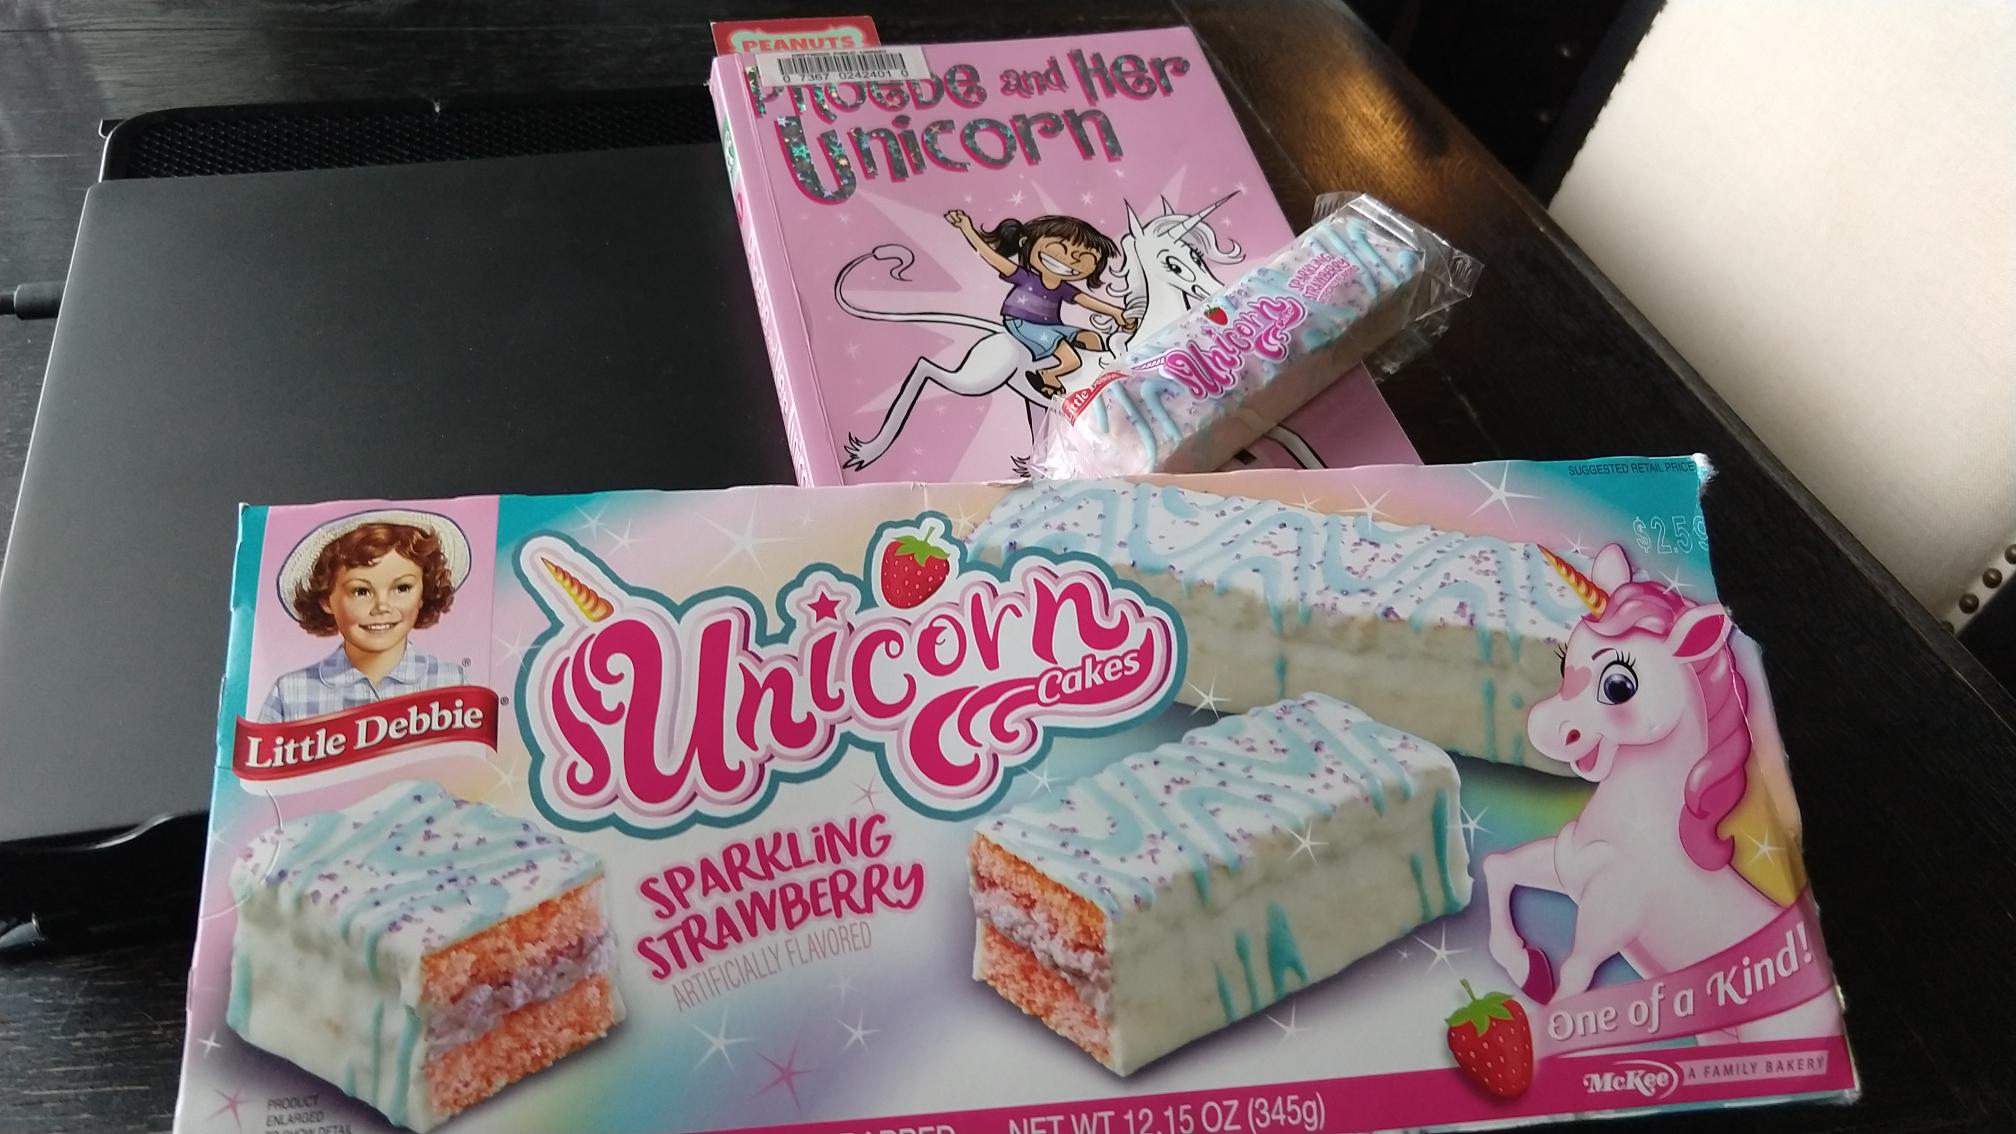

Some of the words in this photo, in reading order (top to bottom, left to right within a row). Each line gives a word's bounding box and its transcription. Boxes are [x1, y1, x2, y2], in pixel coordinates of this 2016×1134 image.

[742, 36, 854, 53] PEANUTS
[800, 73, 830, 82] 7367
[839, 70, 893, 80] 0242401
[1000, 56, 1069, 98] and
[1067, 49, 1190, 106] Her
[774, 109, 1123, 206] Unicorn
[1165, 298, 1287, 400] Unicorn
[1568, 463, 1629, 476] SUGGESTED
[1631, 462, 1664, 474] RETAIL
[551, 578, 1130, 804] Unicorn
[1036, 646, 1141, 706] Cakes
[245, 728, 347, 769] Little
[353, 698, 484, 751] Debbie
[636, 862, 925, 981] STRAWBERRY
[671, 943, 781, 1012] ARTIFICIALLY
[786, 920, 873, 967] FLAVORED
[1548, 1005, 1617, 1040] One
[1628, 982, 1665, 1033] of
[1673, 986, 1694, 1017] a
[1706, 920, 1813, 1006] Kind!
[1584, 1068, 1670, 1097] McKee
[1687, 1066, 1696, 1080] A
[1703, 1061, 1757, 1078] FAMILY
[1766, 1055, 1826, 1073] BAKERY
[265, 1110, 325, 1127] ENLARGED
[266, 1094, 320, 1110] PRODUCT
[1124, 1104, 1194, 1134] 12.15
[1201, 1099, 1242, 1133] OZ
[1248, 1091, 1325, 1133] (345g)
